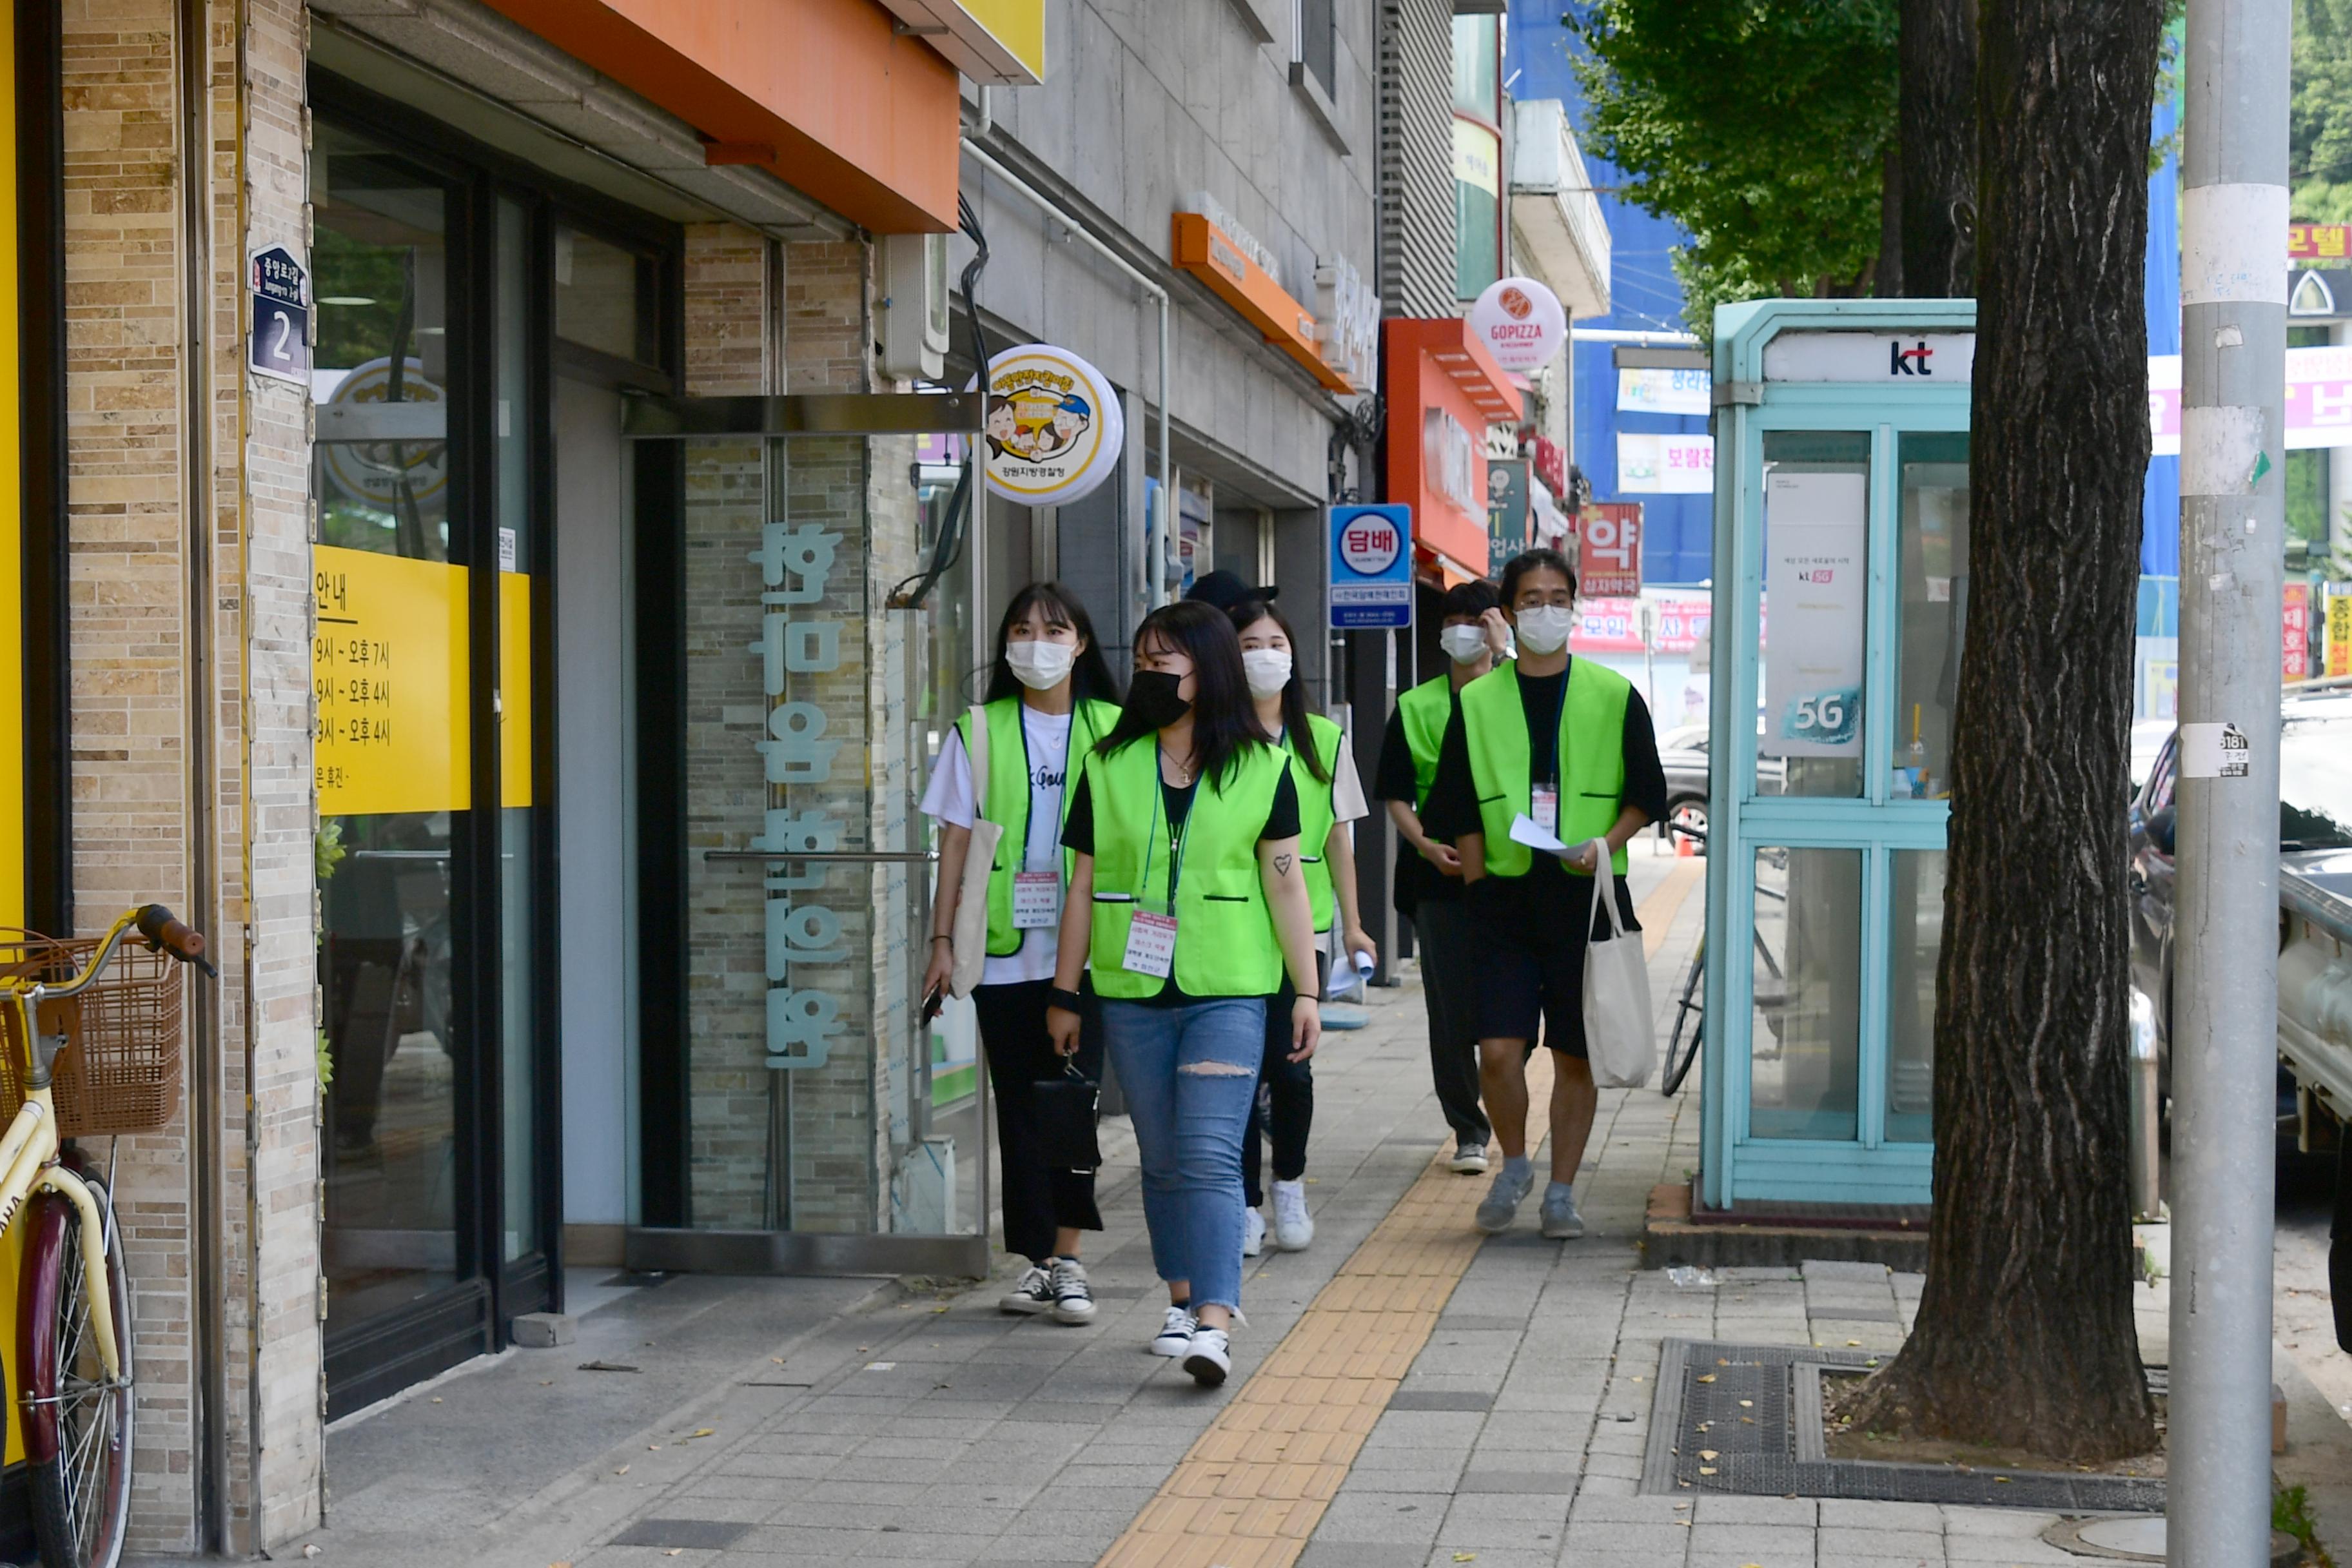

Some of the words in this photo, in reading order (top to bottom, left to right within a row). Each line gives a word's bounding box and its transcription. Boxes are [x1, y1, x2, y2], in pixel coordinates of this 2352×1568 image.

[264, 257, 299, 286] 중앙로2길
[274, 310, 291, 361] 2
[1491, 324, 1542, 340] GOPIZZA
[1891, 341, 1933, 375] kt
[1002, 467, 1065, 477] 강원지방경찰청
[1348, 530, 1393, 553] 담배
[1586, 518, 1638, 570] 약
[317, 571, 346, 611] 안내
[317, 637, 333, 666] 9시
[349, 640, 369, 668] 오후
[373, 642, 389, 669] 7시
[317, 677, 333, 706] 9시
[349, 679, 369, 707] 오후
[373, 680, 389, 709] 4시
[1794, 694, 1843, 730] 5G
[349, 718, 369, 747] 오후
[373, 719, 389, 747] 4시
[316, 767, 324, 789] 은
[327, 767, 342, 789] 휴진
